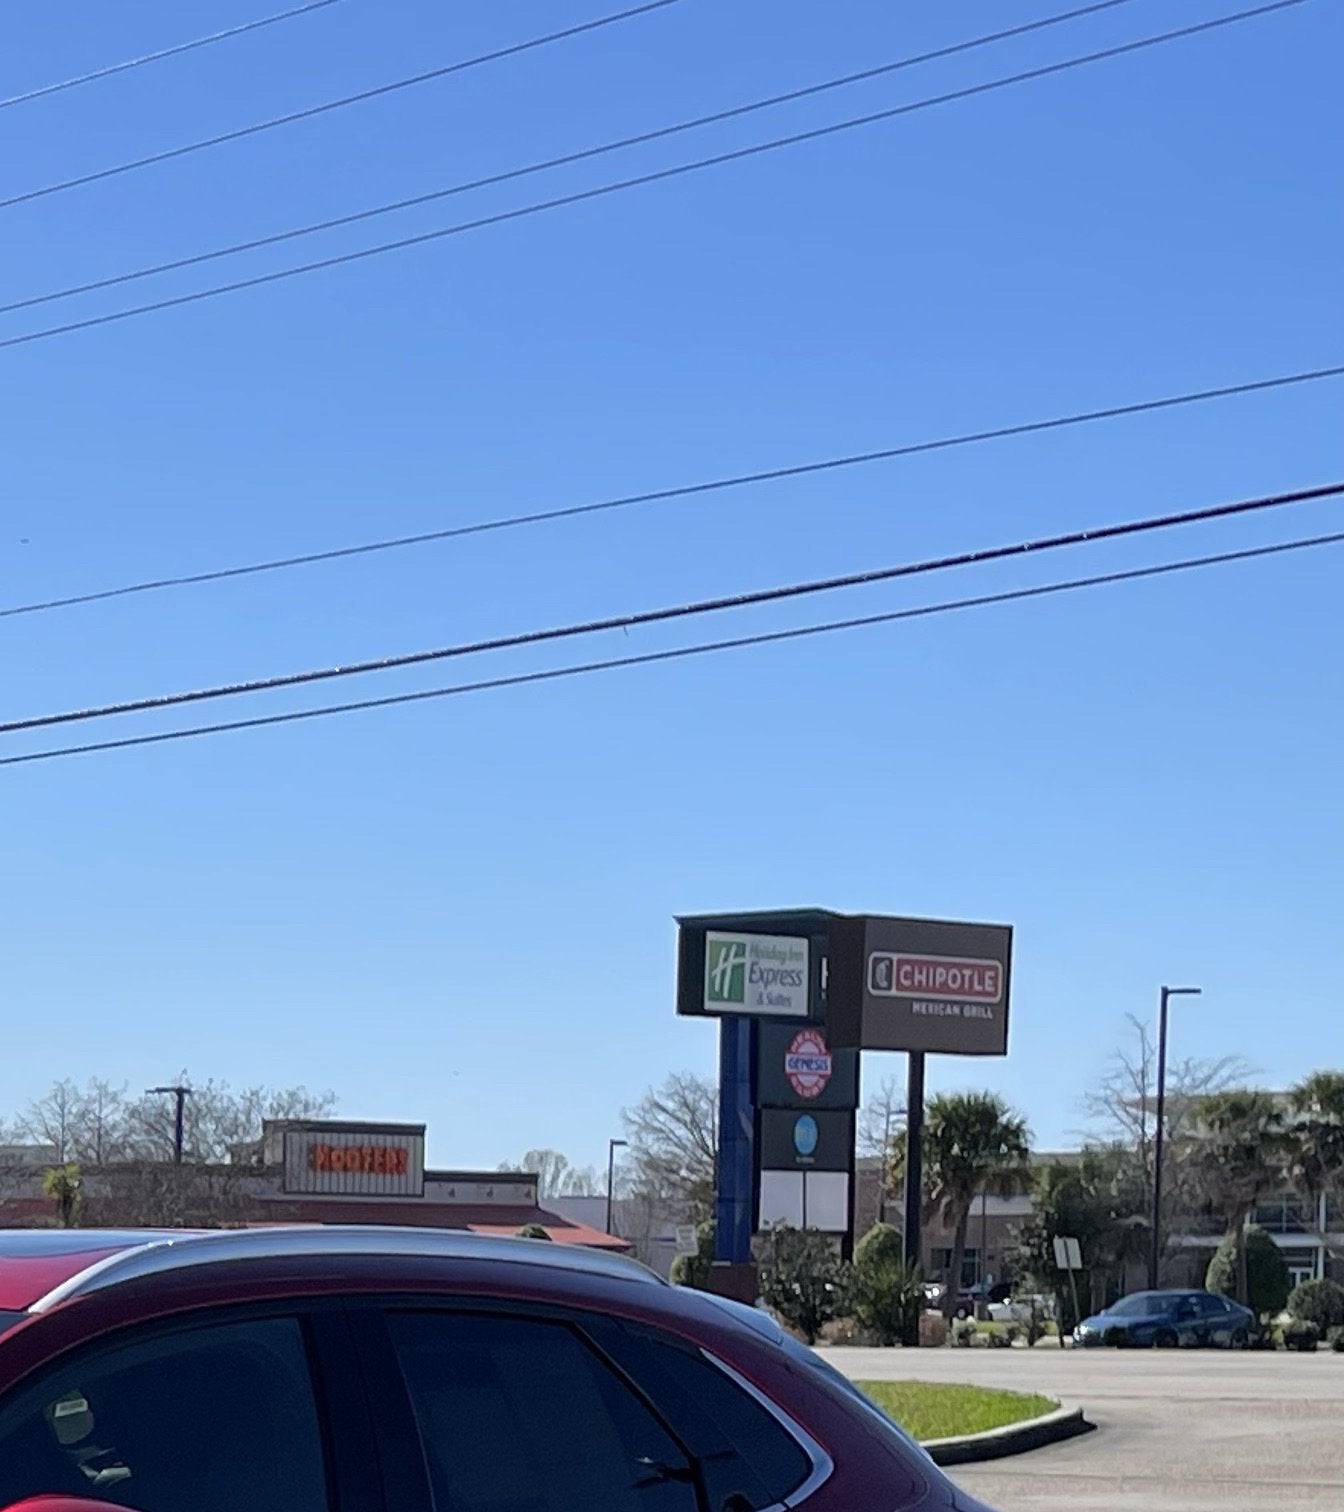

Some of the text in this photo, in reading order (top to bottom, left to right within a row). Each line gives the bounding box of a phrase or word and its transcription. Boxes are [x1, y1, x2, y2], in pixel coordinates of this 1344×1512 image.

[748, 961, 803, 989] Express
[899, 964, 996, 992] CHIPOTLE
[912, 1002, 993, 1019] MEXICAN GRILL
[314, 1143, 408, 1175] HOOTERS
